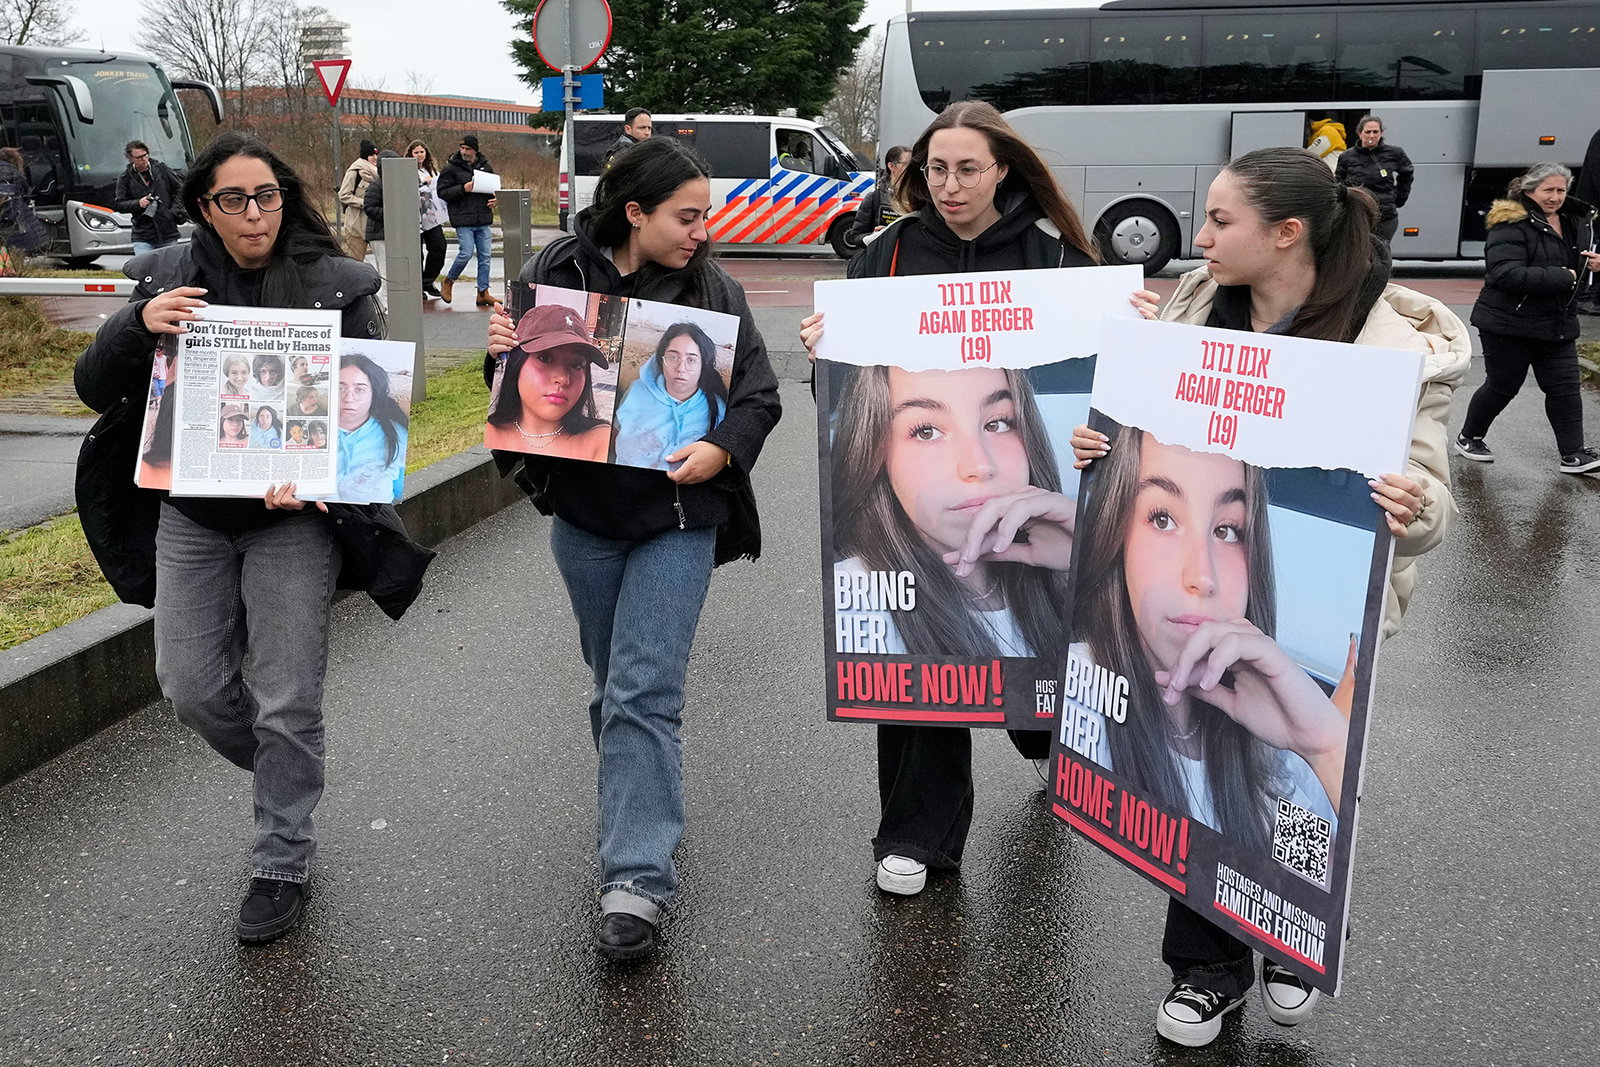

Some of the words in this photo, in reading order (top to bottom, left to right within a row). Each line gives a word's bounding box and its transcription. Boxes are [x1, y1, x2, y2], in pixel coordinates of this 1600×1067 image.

[937, 282, 975, 306] ברגר
[980, 280, 1012, 305] אגם
[186, 322, 216, 335] Don't
[218, 324, 252, 338] forget
[254, 326, 286, 338] them!
[288, 328, 318, 339] Faces
[320, 329, 331, 338] of
[918, 310, 966, 335] AGAM
[971, 307, 1034, 332] BERGER
[185, 336, 212, 349] girls
[213, 337, 247, 349] STILL
[249, 339, 275, 351] held
[276, 340, 290, 353] by
[292, 340, 331, 352] Hamas
[960, 335, 991, 363] (19)
[1201, 340, 1235, 373] ברגר
[1236, 345, 1272, 379] אגם
[1175, 372, 1221, 407] AGAM
[1222, 379, 1286, 419] BERGER
[1207, 411, 1238, 450] (19)
[834, 570, 916, 612] BRING
[835, 613, 889, 654] HER
[836, 660, 914, 703] HOME
[921, 659, 1005, 707] NOW!
[1064, 652, 1130, 725] BRING
[1059, 700, 1100, 763] HER
[1055, 752, 1116, 830] HOME
[1118, 788, 1191, 876] NOW!
[1216, 861, 1262, 903] HOSTAGES
[1262, 888, 1282, 915] AND
[1282, 899, 1326, 941] MISSING
[1215, 879, 1273, 936] FAMILIES
[1273, 913, 1325, 968] FORUM
